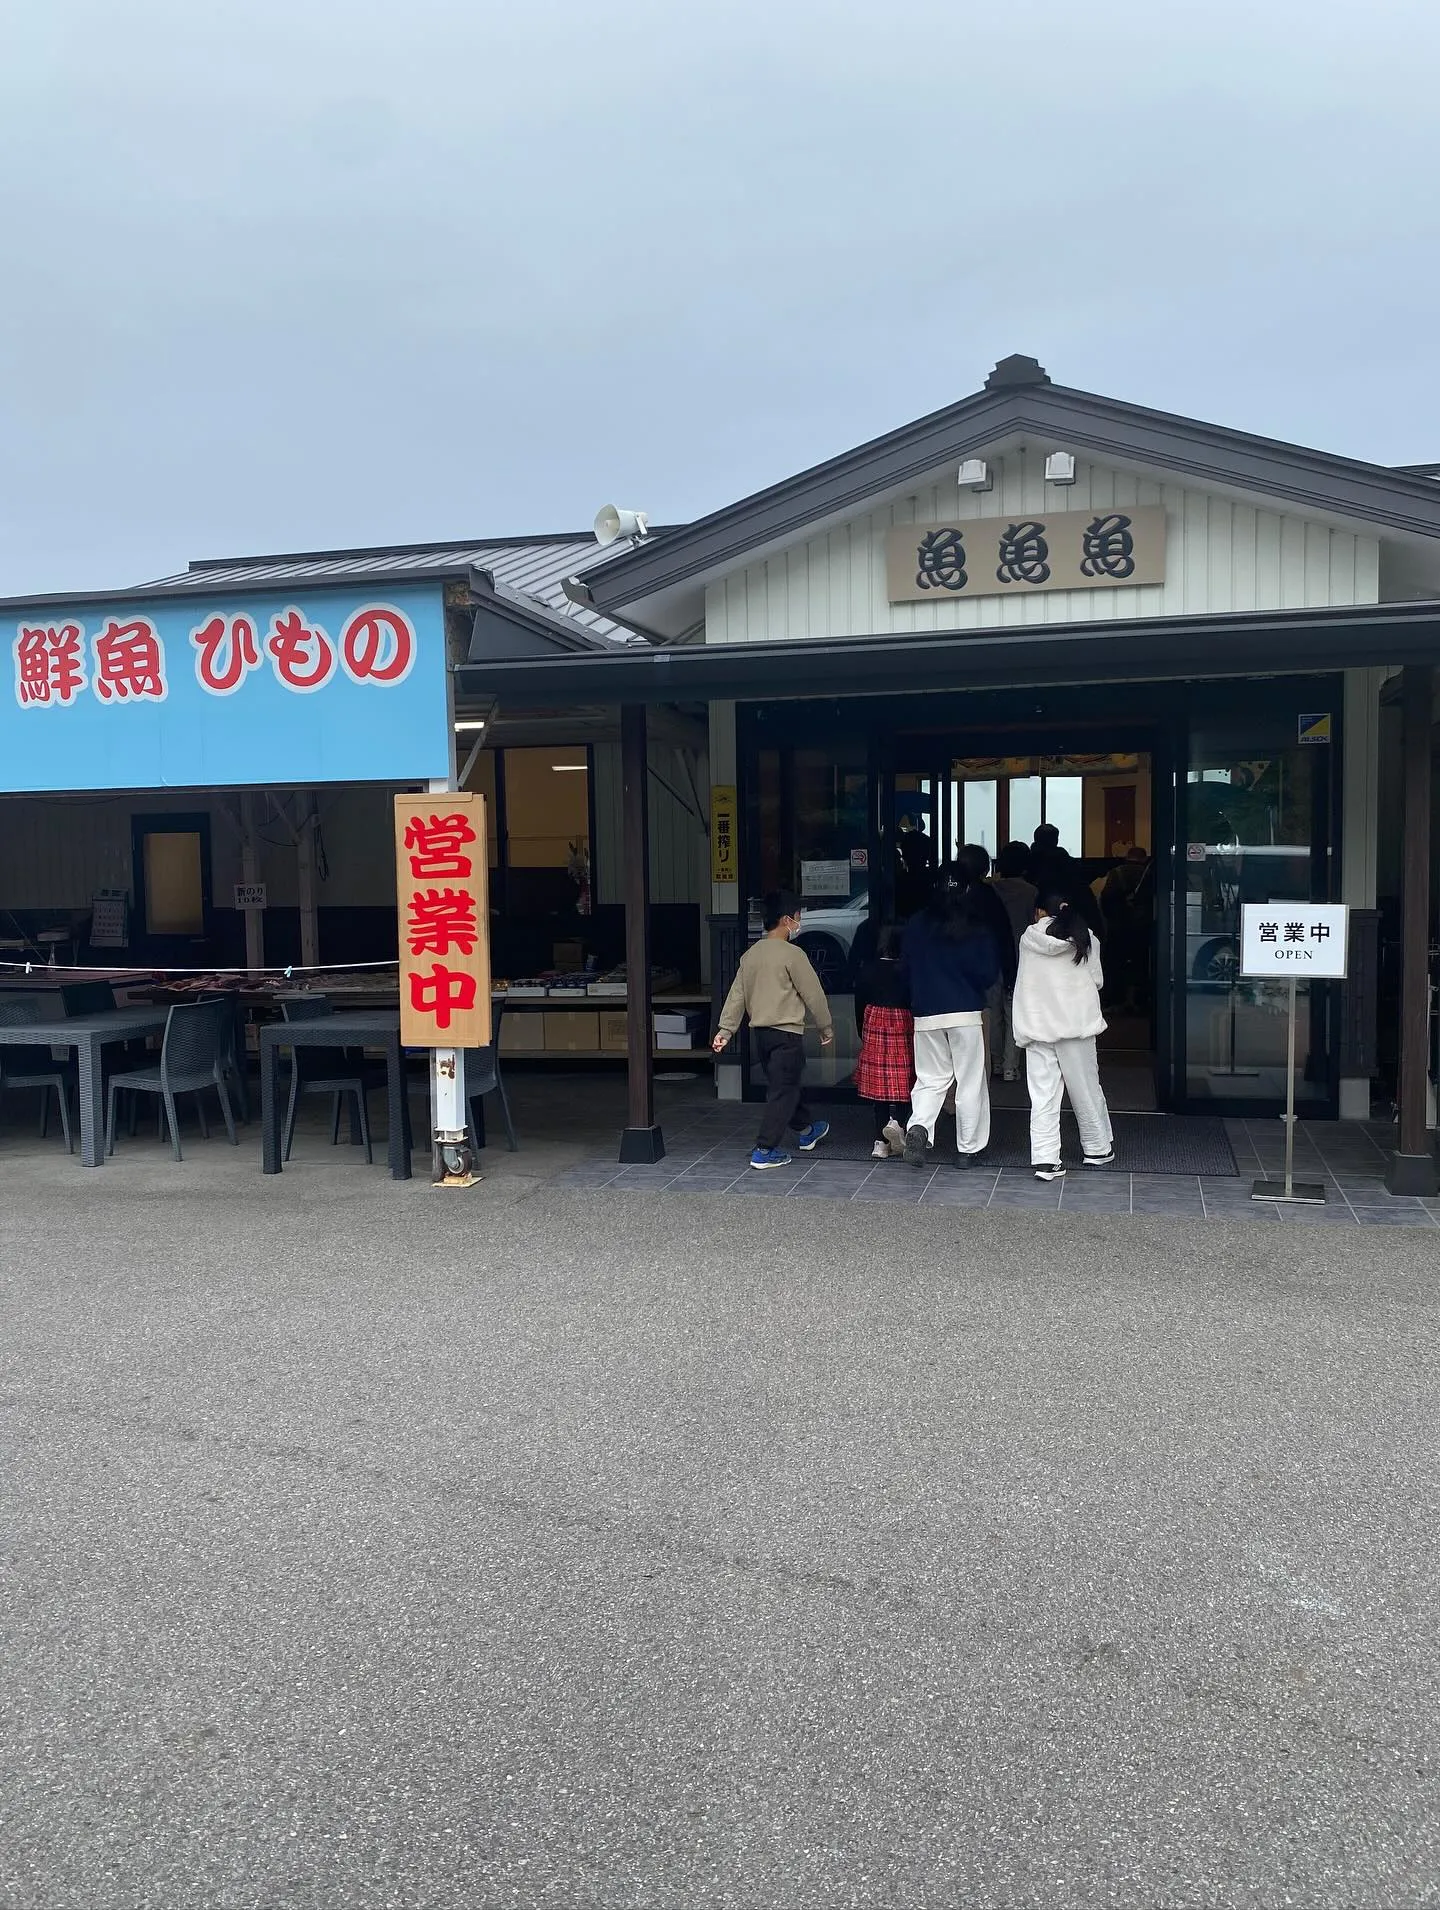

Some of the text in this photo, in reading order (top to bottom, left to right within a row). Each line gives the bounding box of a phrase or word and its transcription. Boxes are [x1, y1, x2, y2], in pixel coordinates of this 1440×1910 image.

[915, 513, 1136, 591] 魚魚魚
[16, 606, 413, 706] 鮮魚 ひもの
[717, 813, 731, 863] 一番搾り
[403, 813, 478, 1029] 営業中
[1258, 922, 1330, 943] 営業中
[1274, 950, 1313, 960] OPEN
